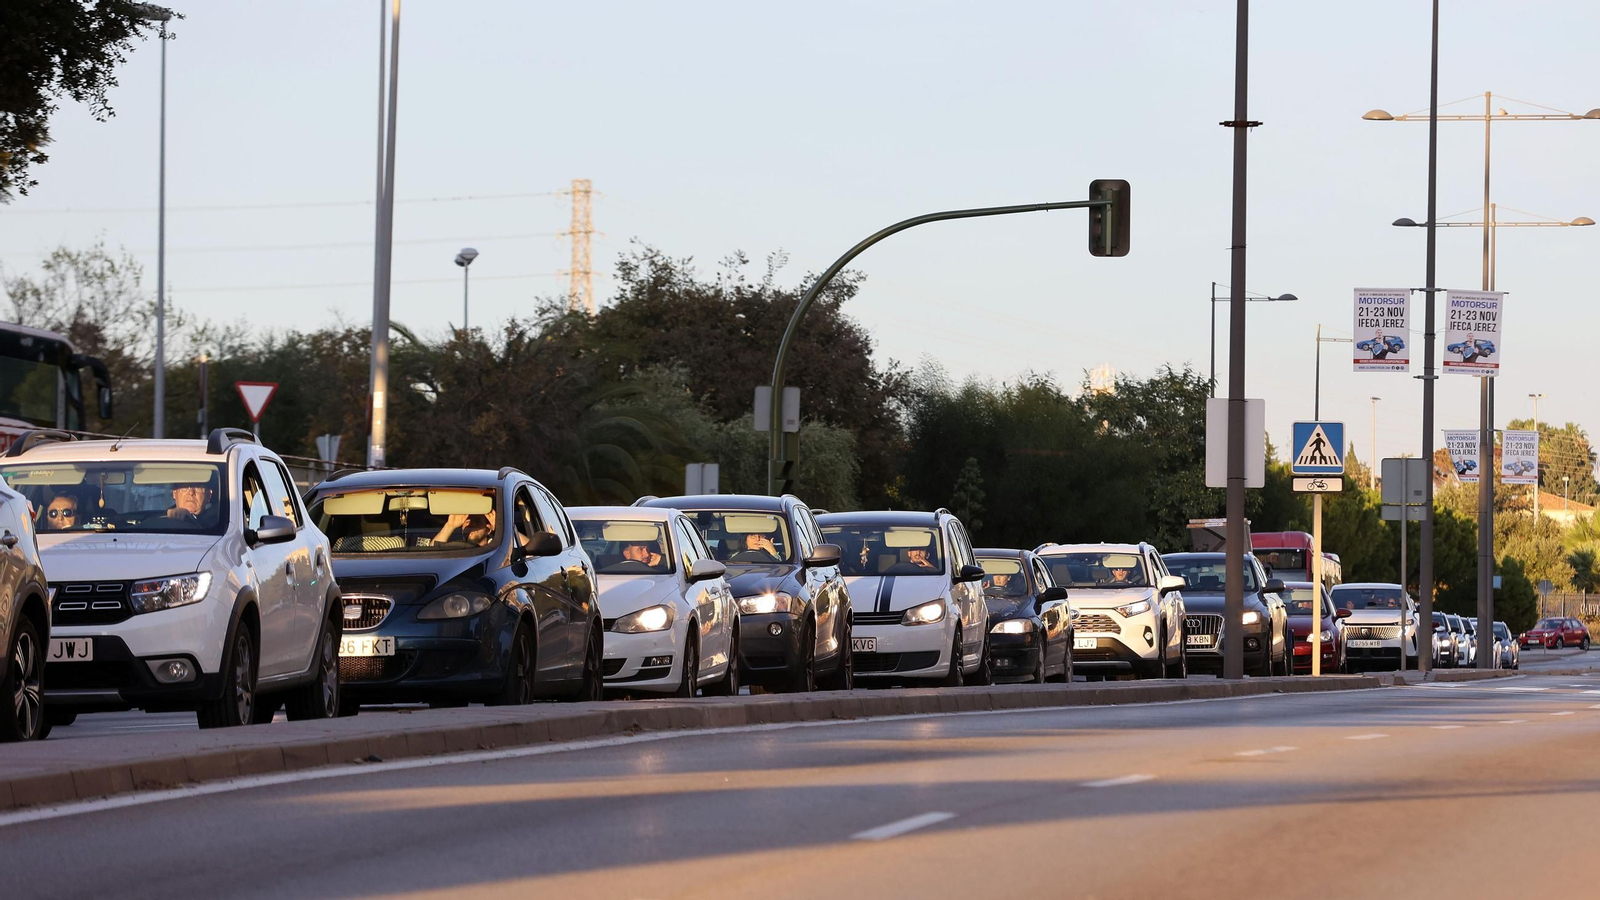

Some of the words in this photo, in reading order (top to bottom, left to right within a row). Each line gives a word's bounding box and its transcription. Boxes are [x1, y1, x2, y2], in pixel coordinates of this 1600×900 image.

[1358, 297, 1405, 305] MOTORSUR
[1451, 300, 1498, 309] MOTORSUR
[1358, 306, 1385, 317] 21-23
[1387, 306, 1405, 317] NOV
[1450, 309, 1477, 321] 21-23
[1480, 310, 1498, 322] NOV
[1358, 318, 1380, 328] IFECA
[1382, 318, 1405, 328] JEREZ
[1450, 321, 1472, 331] IFECA
[1474, 322, 1497, 333] JEREZ
[1465, 441, 1477, 449] NOV
[1505, 441, 1523, 449] 21-23
[1524, 442, 1536, 450] NOV
[1520, 449, 1535, 457] JEREZ
[361, 639, 391, 654] FKT
[853, 639, 874, 650] KVG
[53, 641, 88, 659] JWJ
